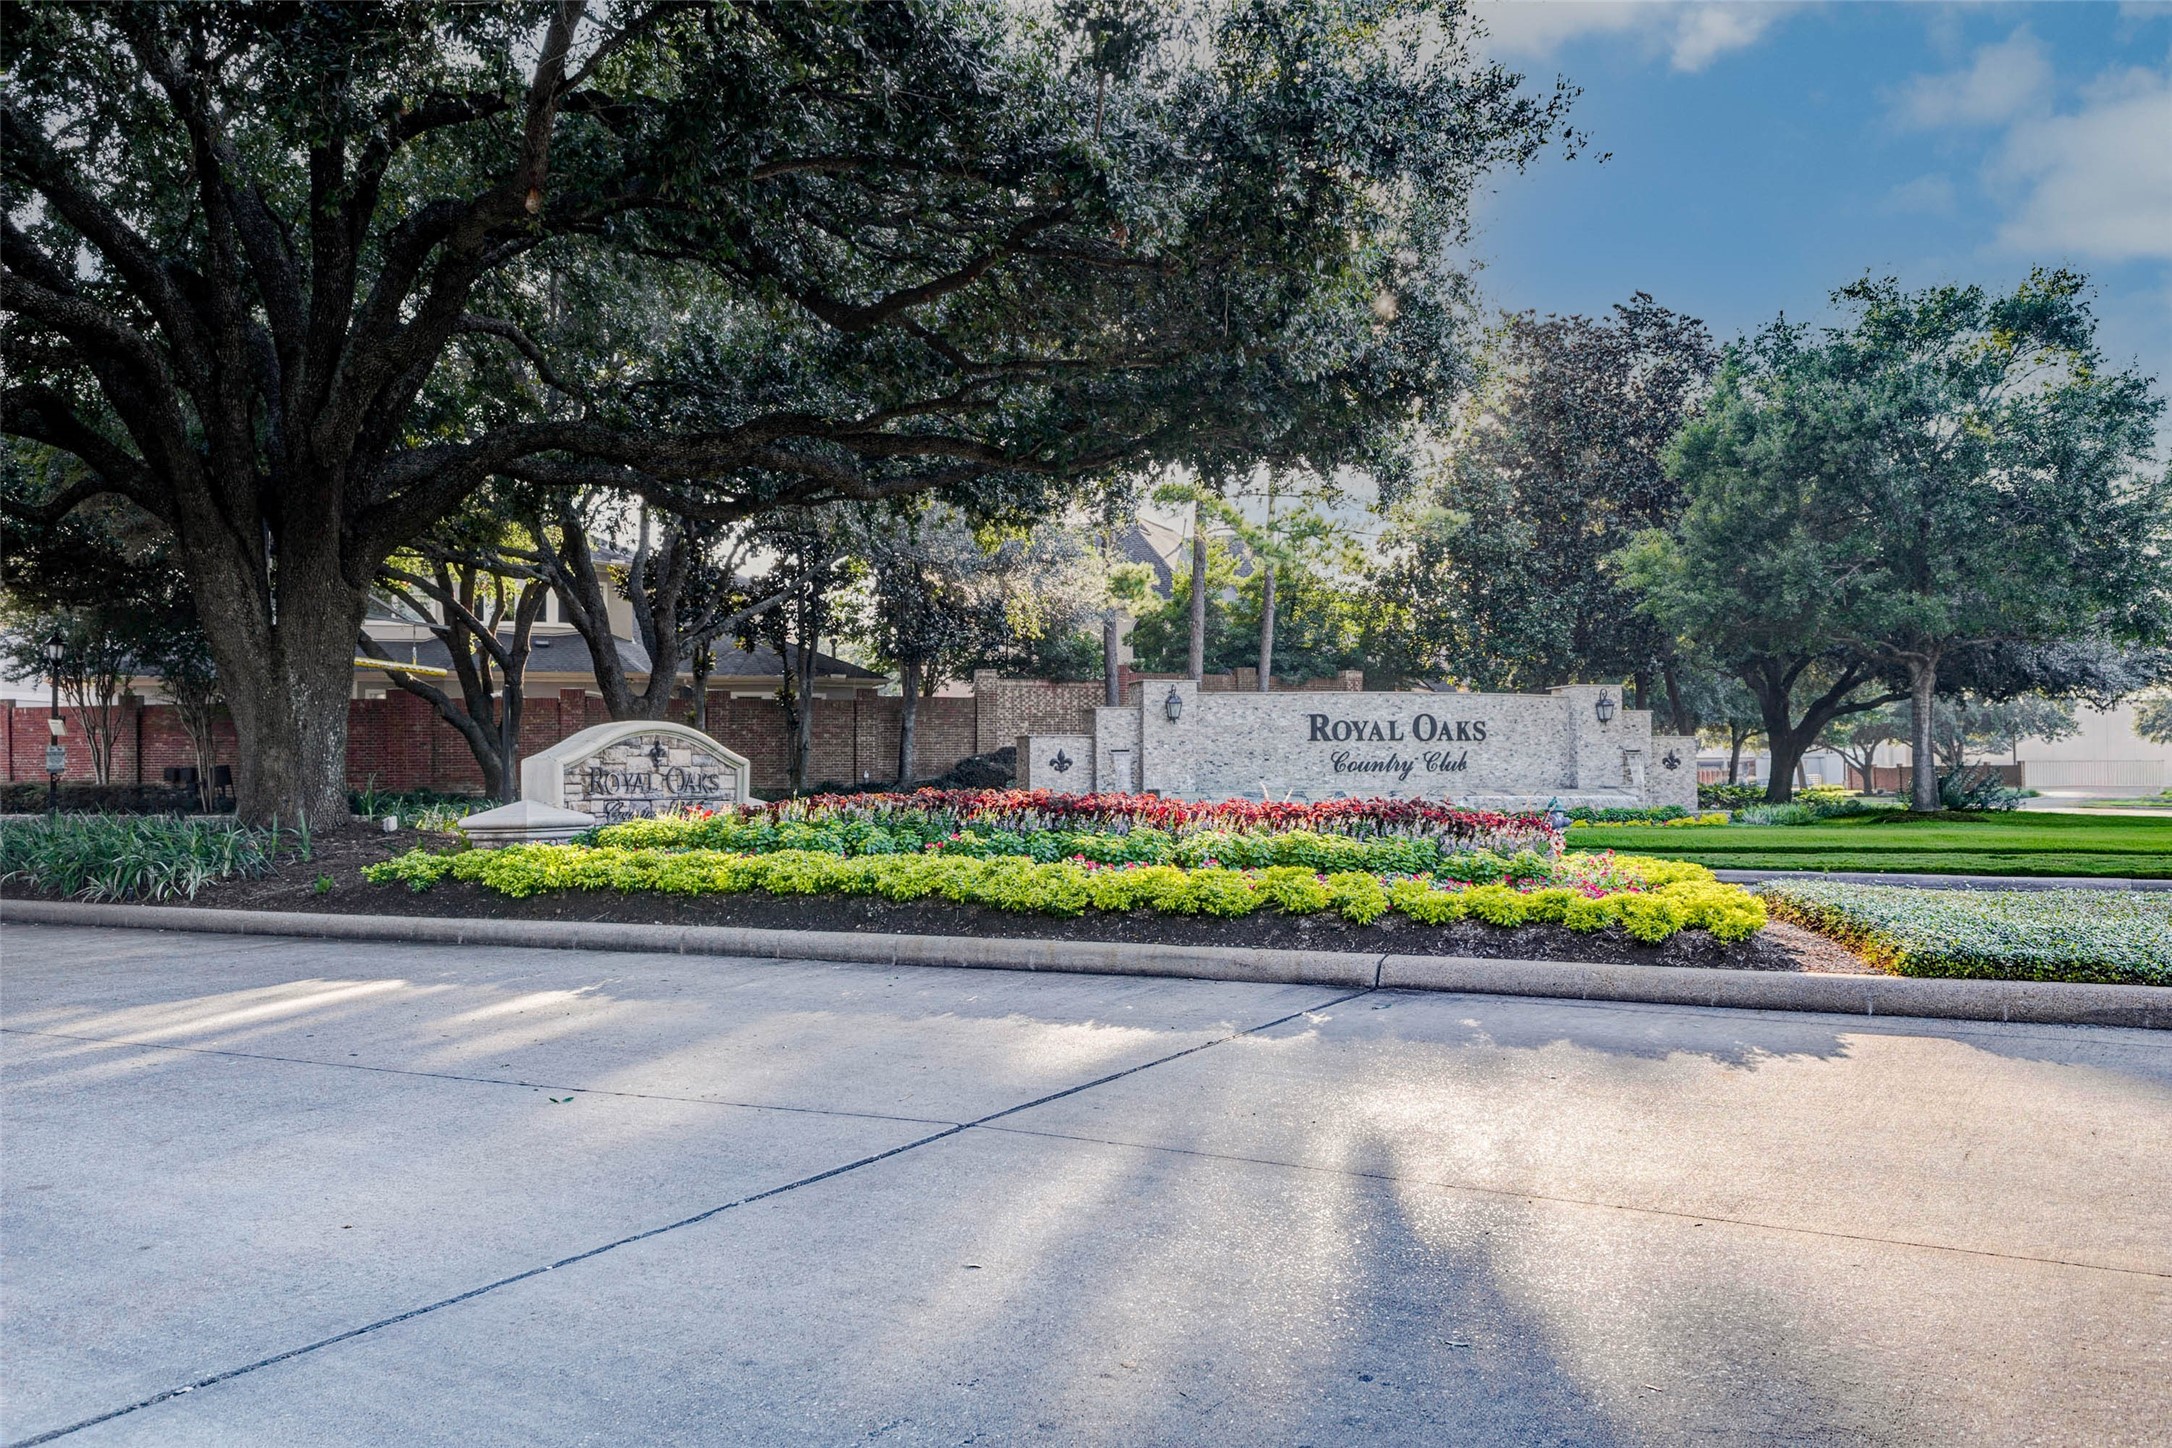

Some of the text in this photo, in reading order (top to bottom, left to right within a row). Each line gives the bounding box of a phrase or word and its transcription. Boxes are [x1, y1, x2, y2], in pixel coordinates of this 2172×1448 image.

[1307, 713, 1487, 742] ROYAL OAKS
[590, 766, 720, 795] ROYAL OAKS
[1331, 751, 1468, 781] Country Club
